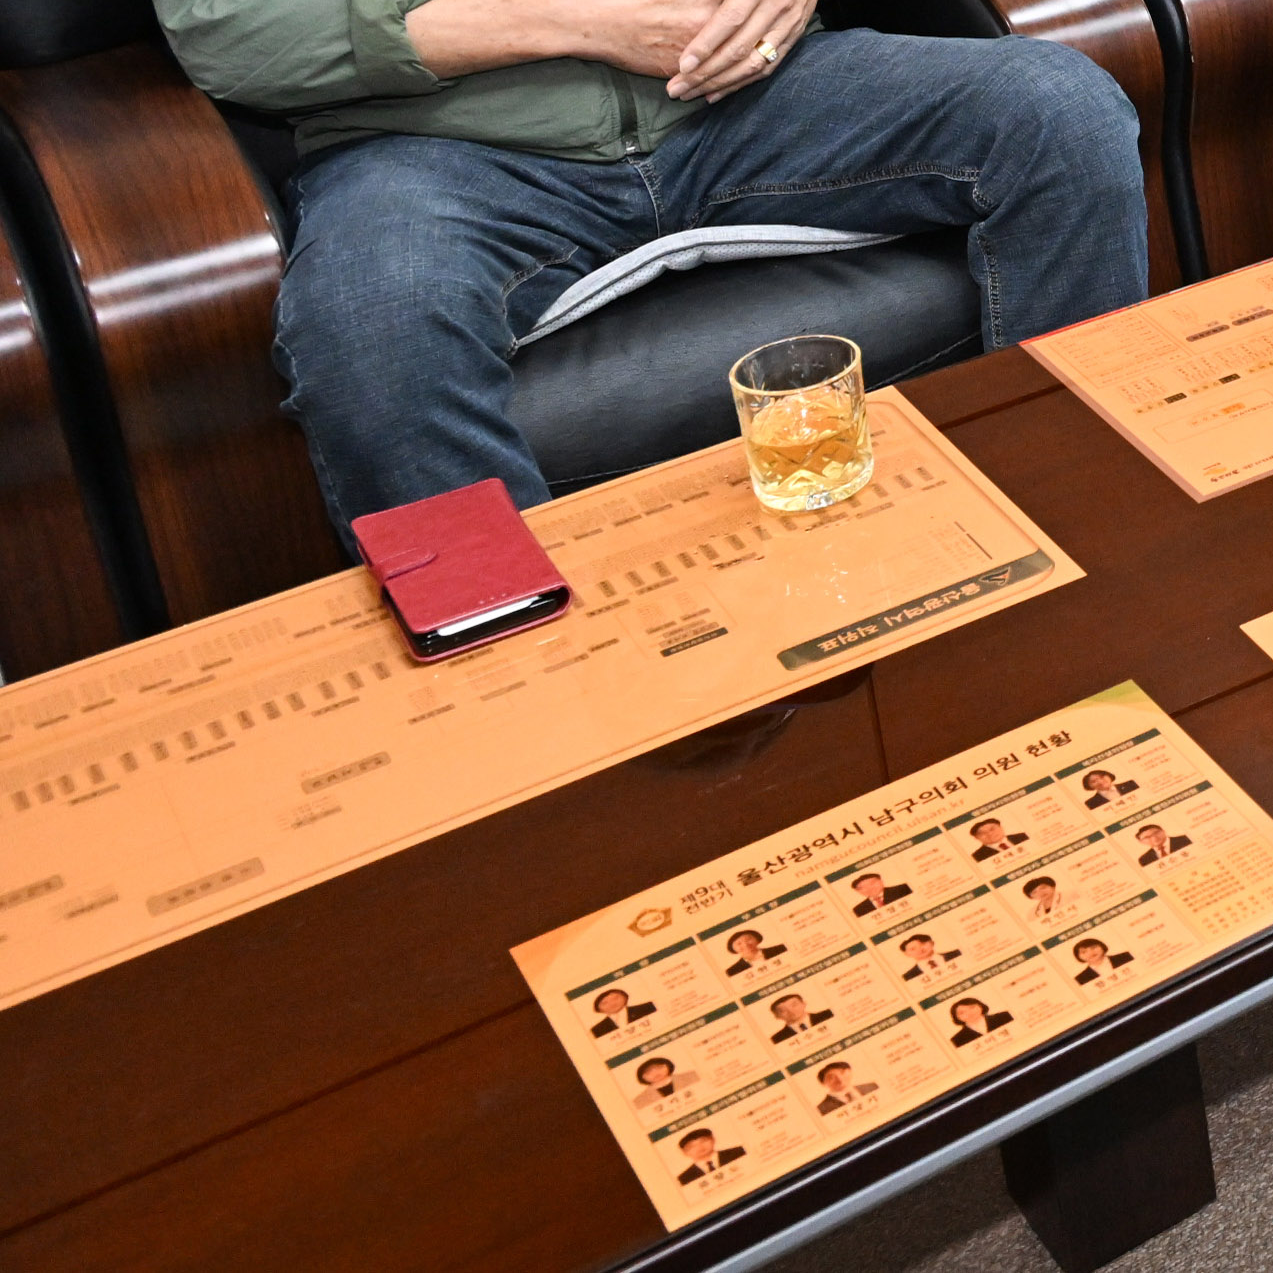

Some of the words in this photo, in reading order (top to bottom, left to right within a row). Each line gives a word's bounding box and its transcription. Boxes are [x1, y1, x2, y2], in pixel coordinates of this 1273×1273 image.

[883, 582, 981, 628] 울산광역시
[817, 624, 880, 653] 직위표
[732, 820, 865, 888] 울산광역시
[866, 775, 970, 829] 남구의회
[969, 751, 1024, 783] 의원
[1022, 728, 1077, 759] 현황
[677, 878, 728, 906] 제9대
[683, 886, 736, 916] 전반기
